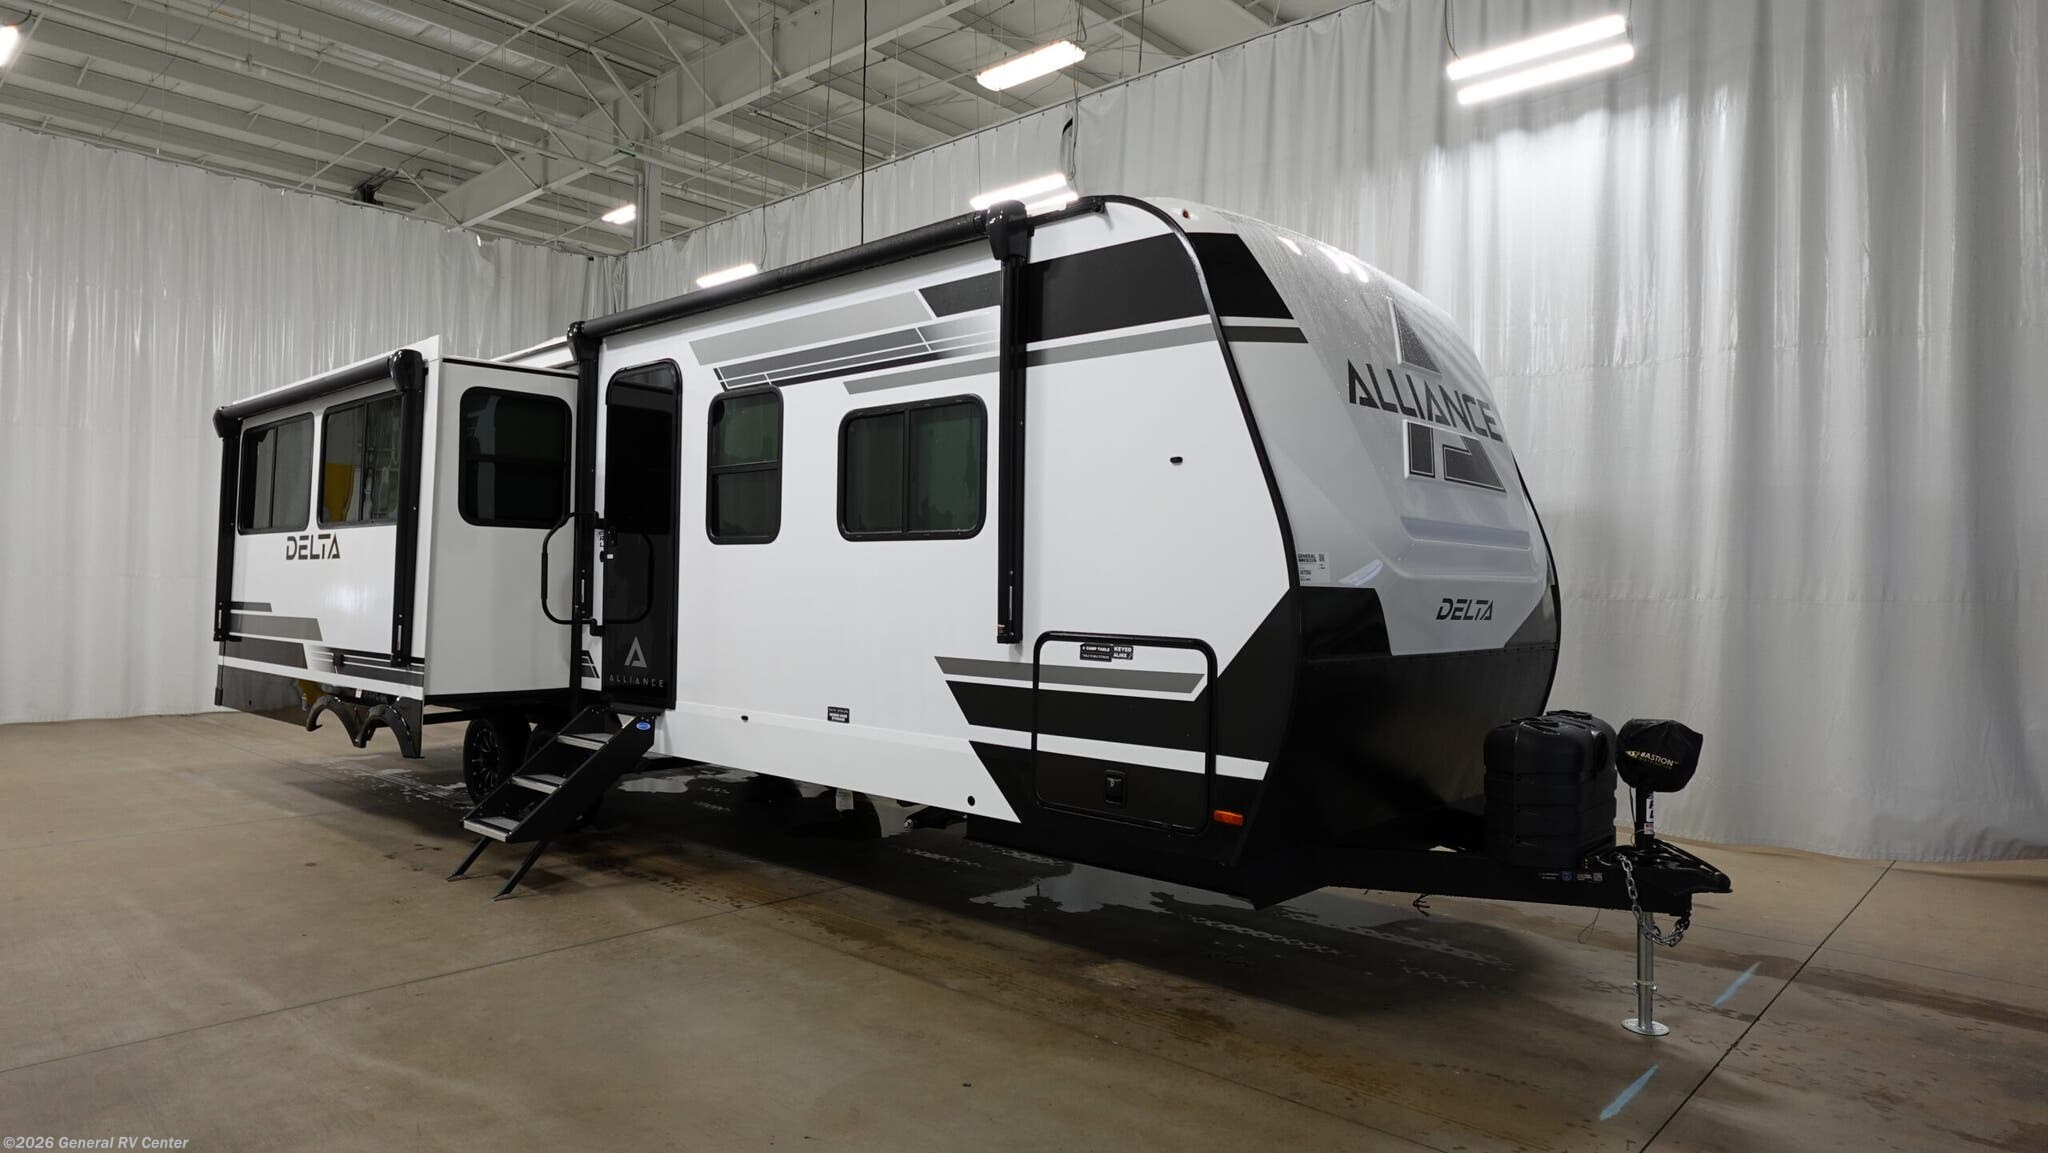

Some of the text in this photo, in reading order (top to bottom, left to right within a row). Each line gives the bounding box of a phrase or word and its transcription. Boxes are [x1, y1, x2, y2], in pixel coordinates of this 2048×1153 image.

[1347, 359, 1504, 442] ALLIANCE
[285, 532, 341, 560] DELTA
[1436, 598, 1494, 620] DELTA
[609, 674, 664, 687] ALLIANCE
